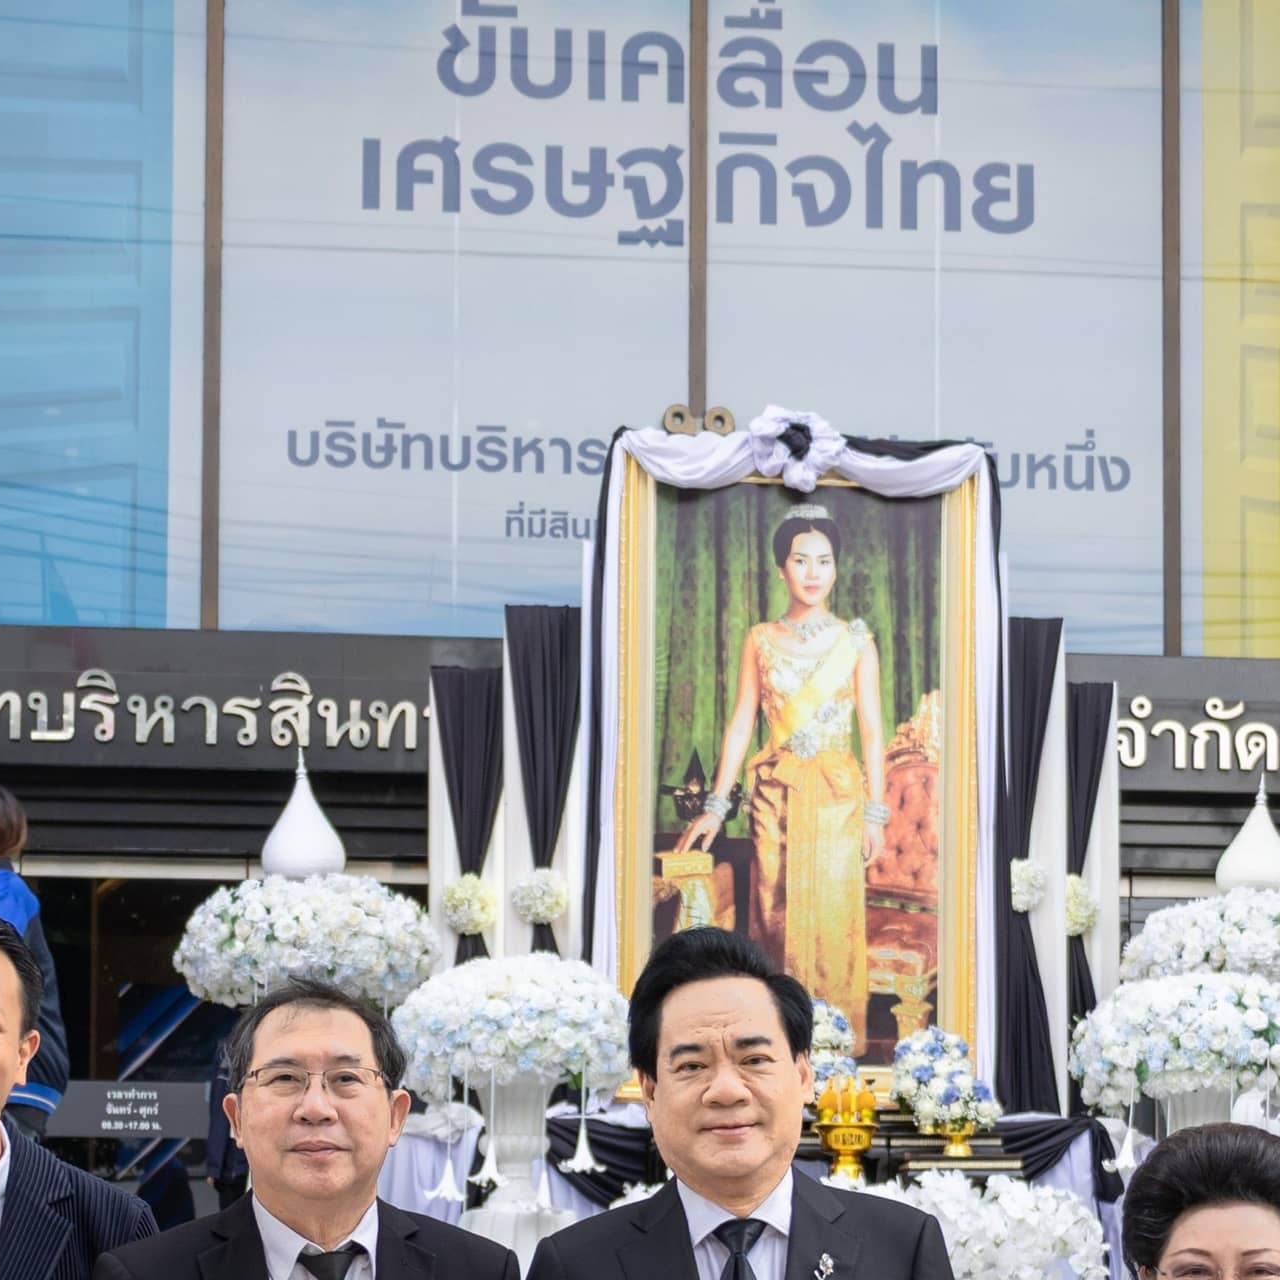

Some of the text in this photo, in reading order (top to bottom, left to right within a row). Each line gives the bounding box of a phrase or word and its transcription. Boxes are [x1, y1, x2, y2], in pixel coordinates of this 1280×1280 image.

[360, 122, 1036, 248] เศรษฐกิจไทย
[1118, 695, 1279, 771] จำกัด
